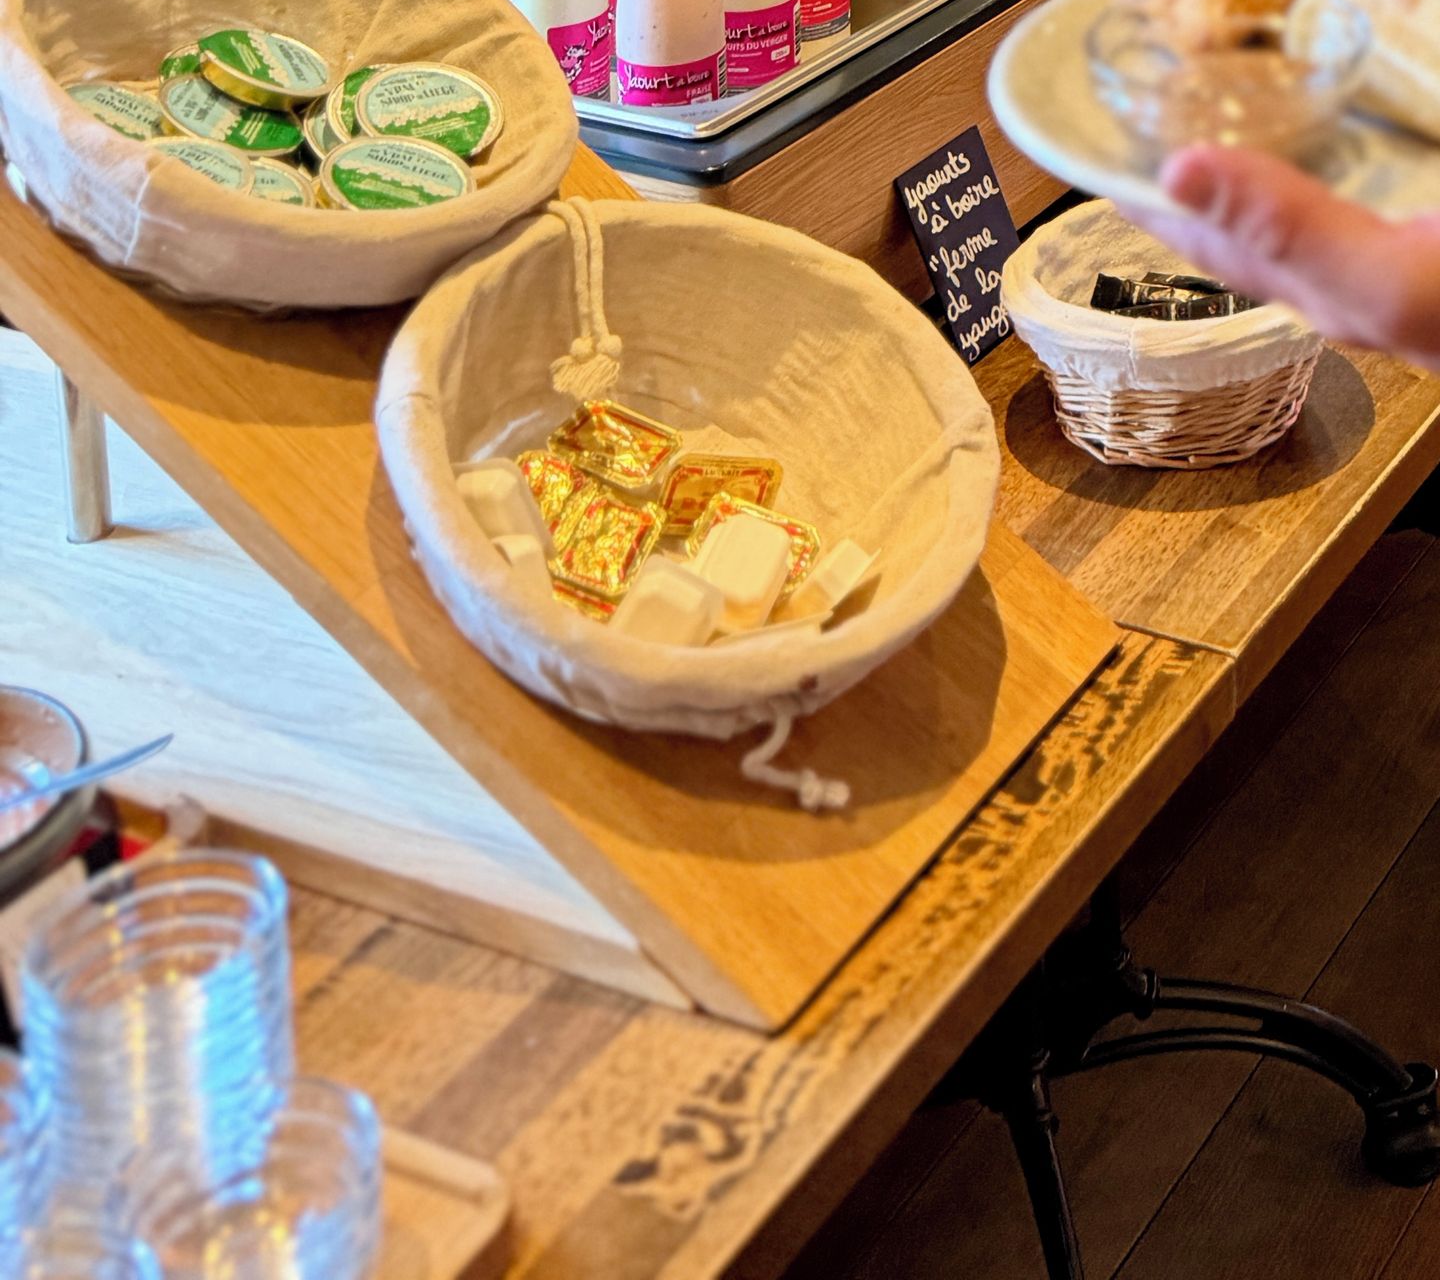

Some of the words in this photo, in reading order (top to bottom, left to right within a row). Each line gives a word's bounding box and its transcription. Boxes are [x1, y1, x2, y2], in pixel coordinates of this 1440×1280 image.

[726, 42, 745, 52] UITS
[746, 41, 760, 51] DU
[623, 64, 675, 91] Yaourt
[930, 201, 950, 234] à
[945, 174, 999, 220] boire
[946, 289, 972, 322] de
[974, 267, 1002, 295] la
